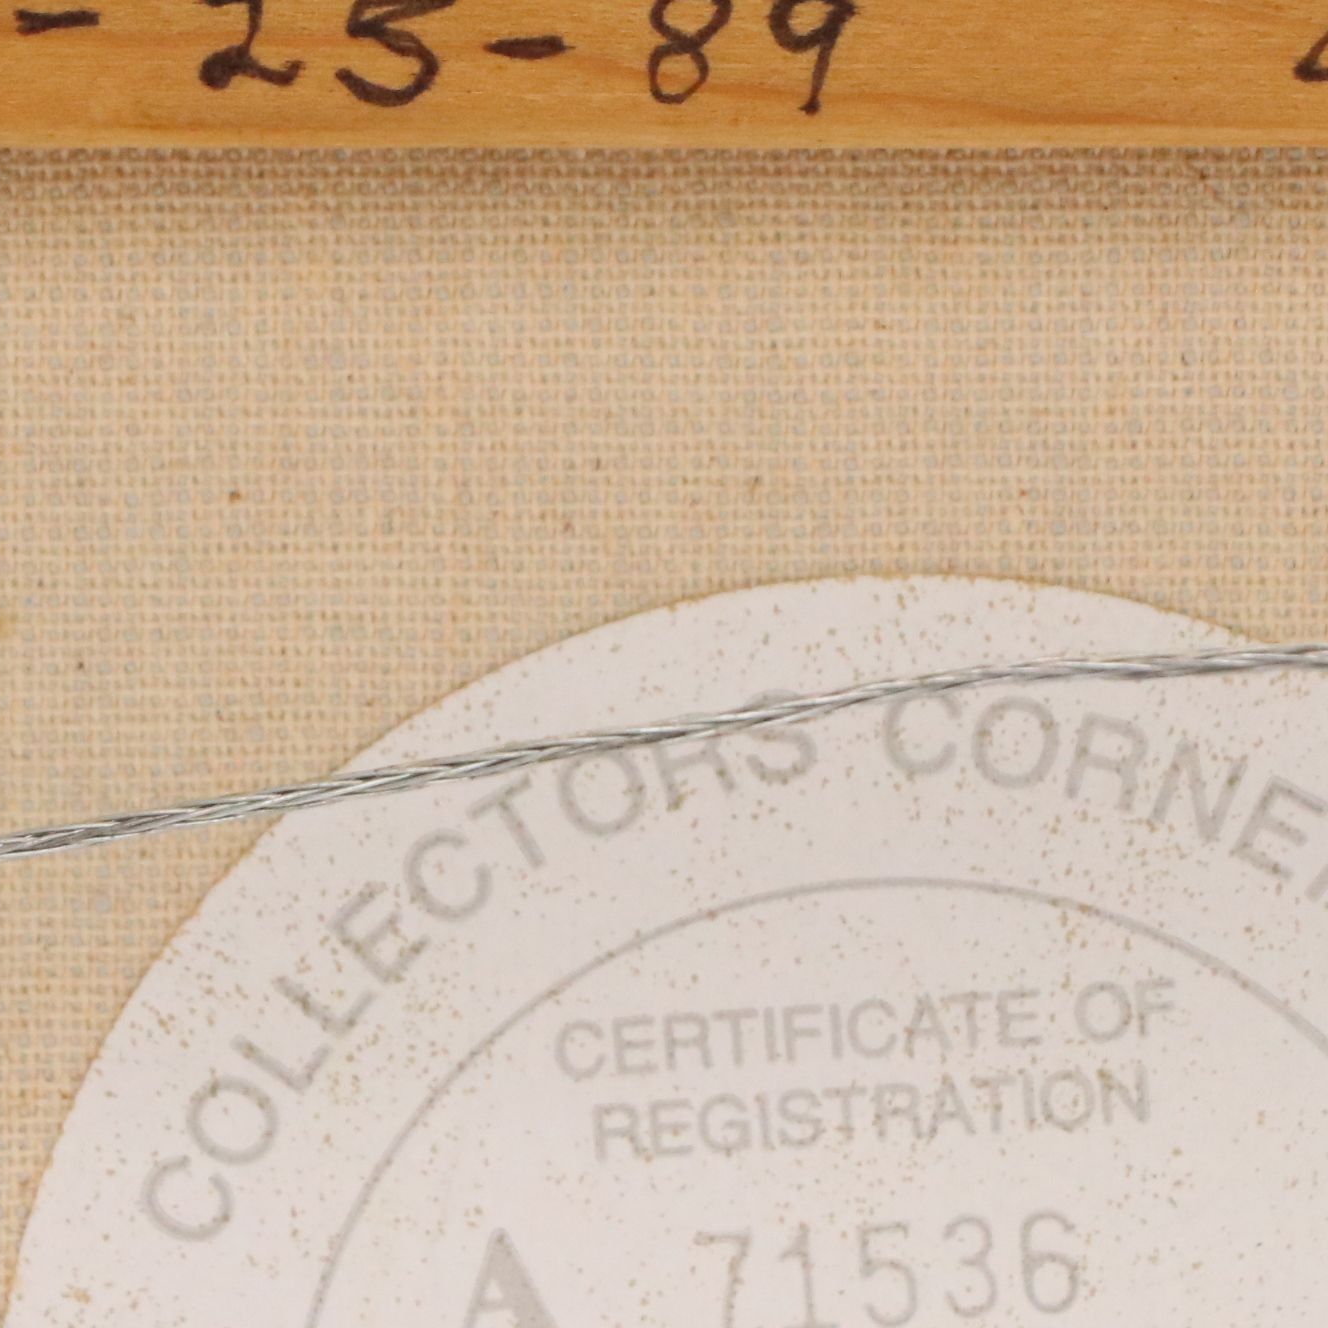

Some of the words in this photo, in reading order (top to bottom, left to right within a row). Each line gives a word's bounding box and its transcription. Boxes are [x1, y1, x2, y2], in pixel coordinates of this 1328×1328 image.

[142, 688, 817, 1242] COLLECTORS
[553, 988, 1042, 1081] CERTIFICATE
[1073, 978, 1174, 1043] OF
[591, 1066, 1152, 1162] REGISTRATION
[692, 1208, 1078, 1328] 71536
